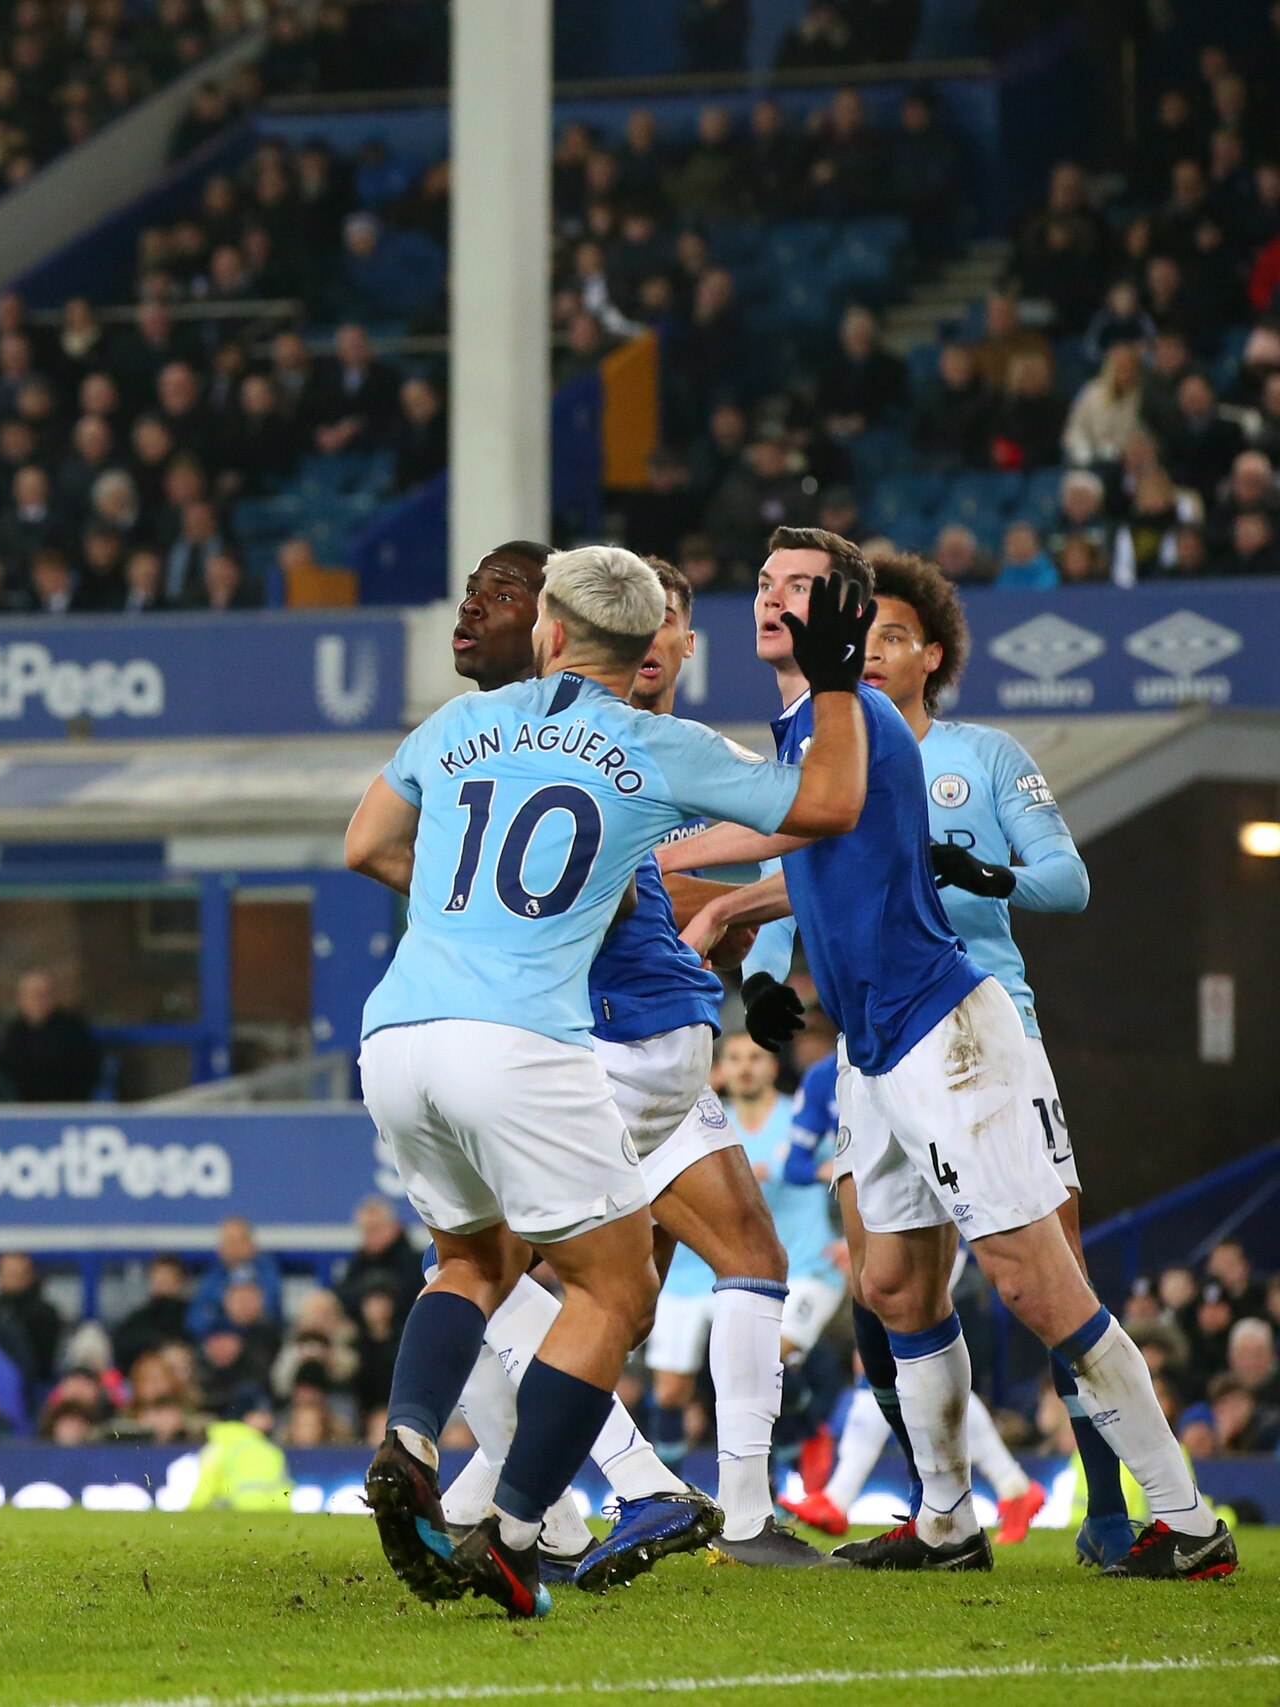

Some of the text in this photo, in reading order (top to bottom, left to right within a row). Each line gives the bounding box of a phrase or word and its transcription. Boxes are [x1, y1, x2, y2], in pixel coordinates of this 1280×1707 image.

[563, 673, 583, 685] CITY
[440, 718, 644, 795] KUN AGÜERO
[442, 779, 603, 920] 10
[928, 1142, 961, 1194] 4
